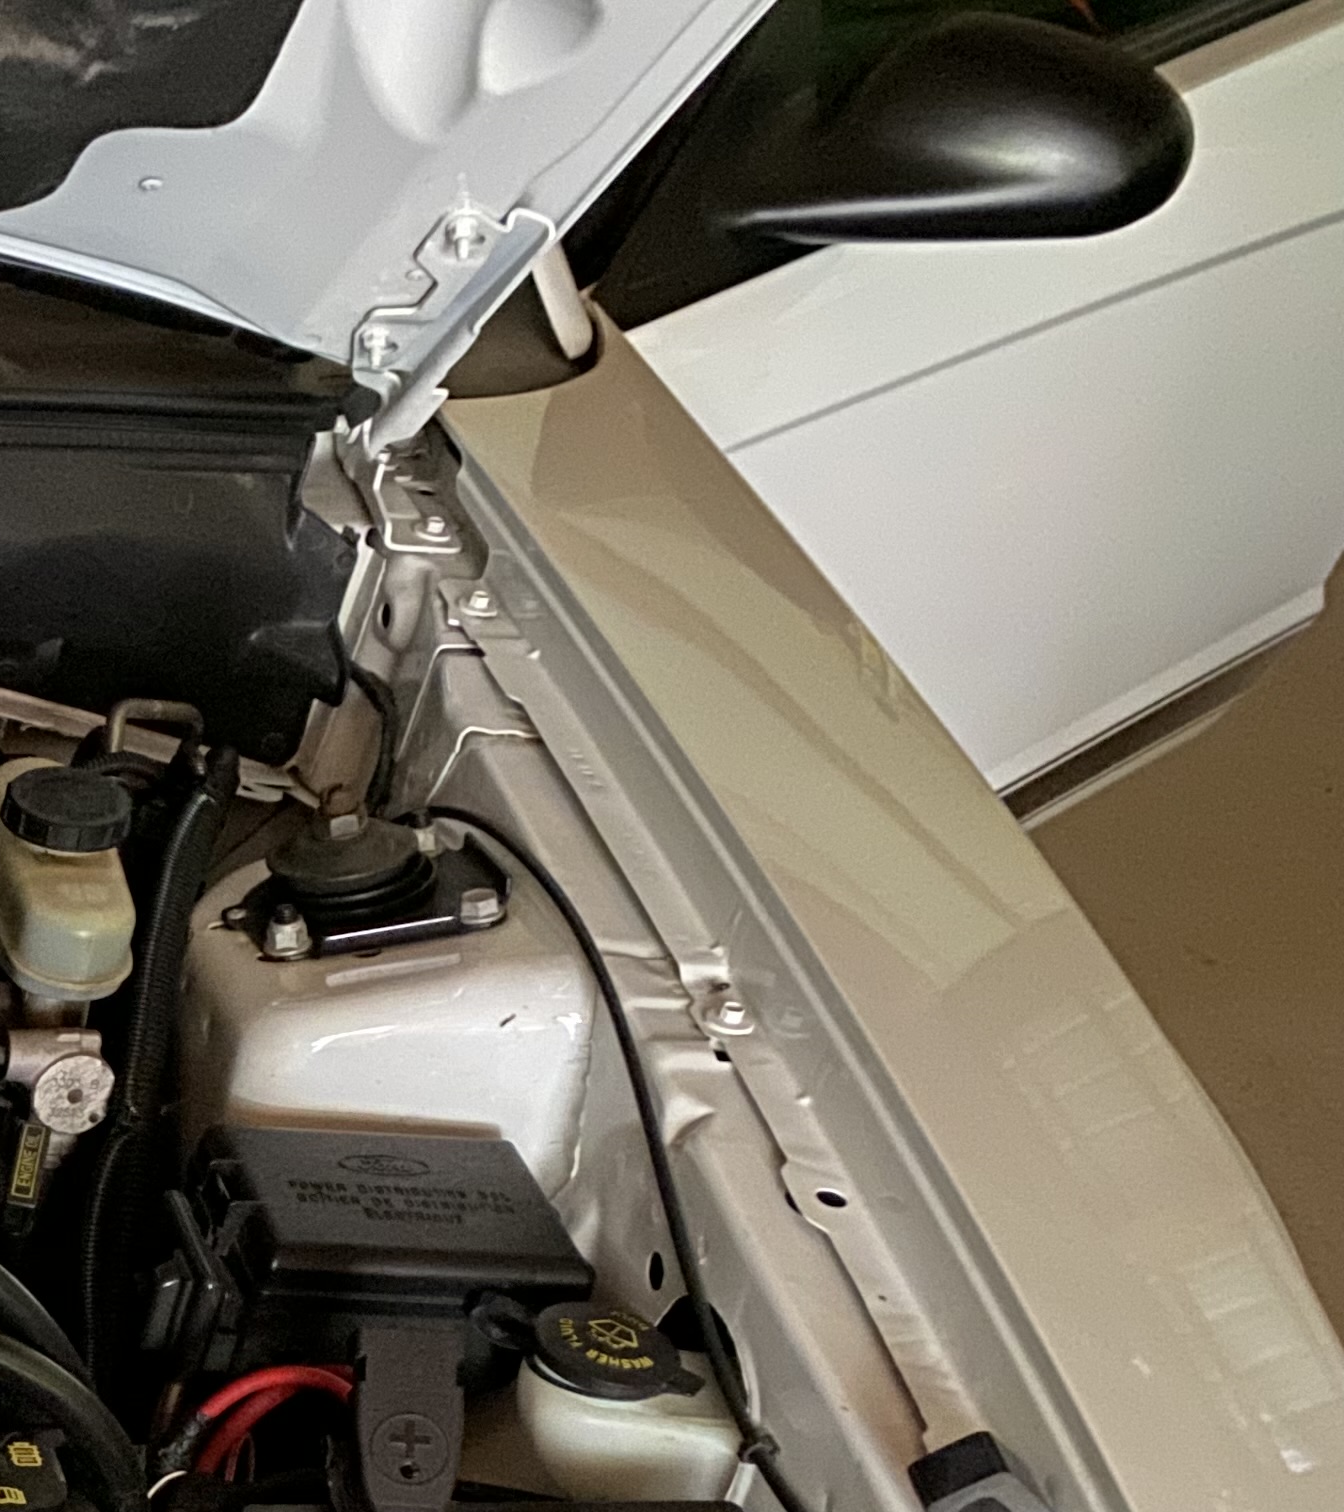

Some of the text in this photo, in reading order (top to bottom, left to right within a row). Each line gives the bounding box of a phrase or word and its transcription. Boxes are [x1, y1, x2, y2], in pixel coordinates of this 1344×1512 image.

[16, 1149, 37, 1187] ENGINE
[558, 1317, 584, 1348] FLUID
[585, 1348, 655, 1370] WASHER
